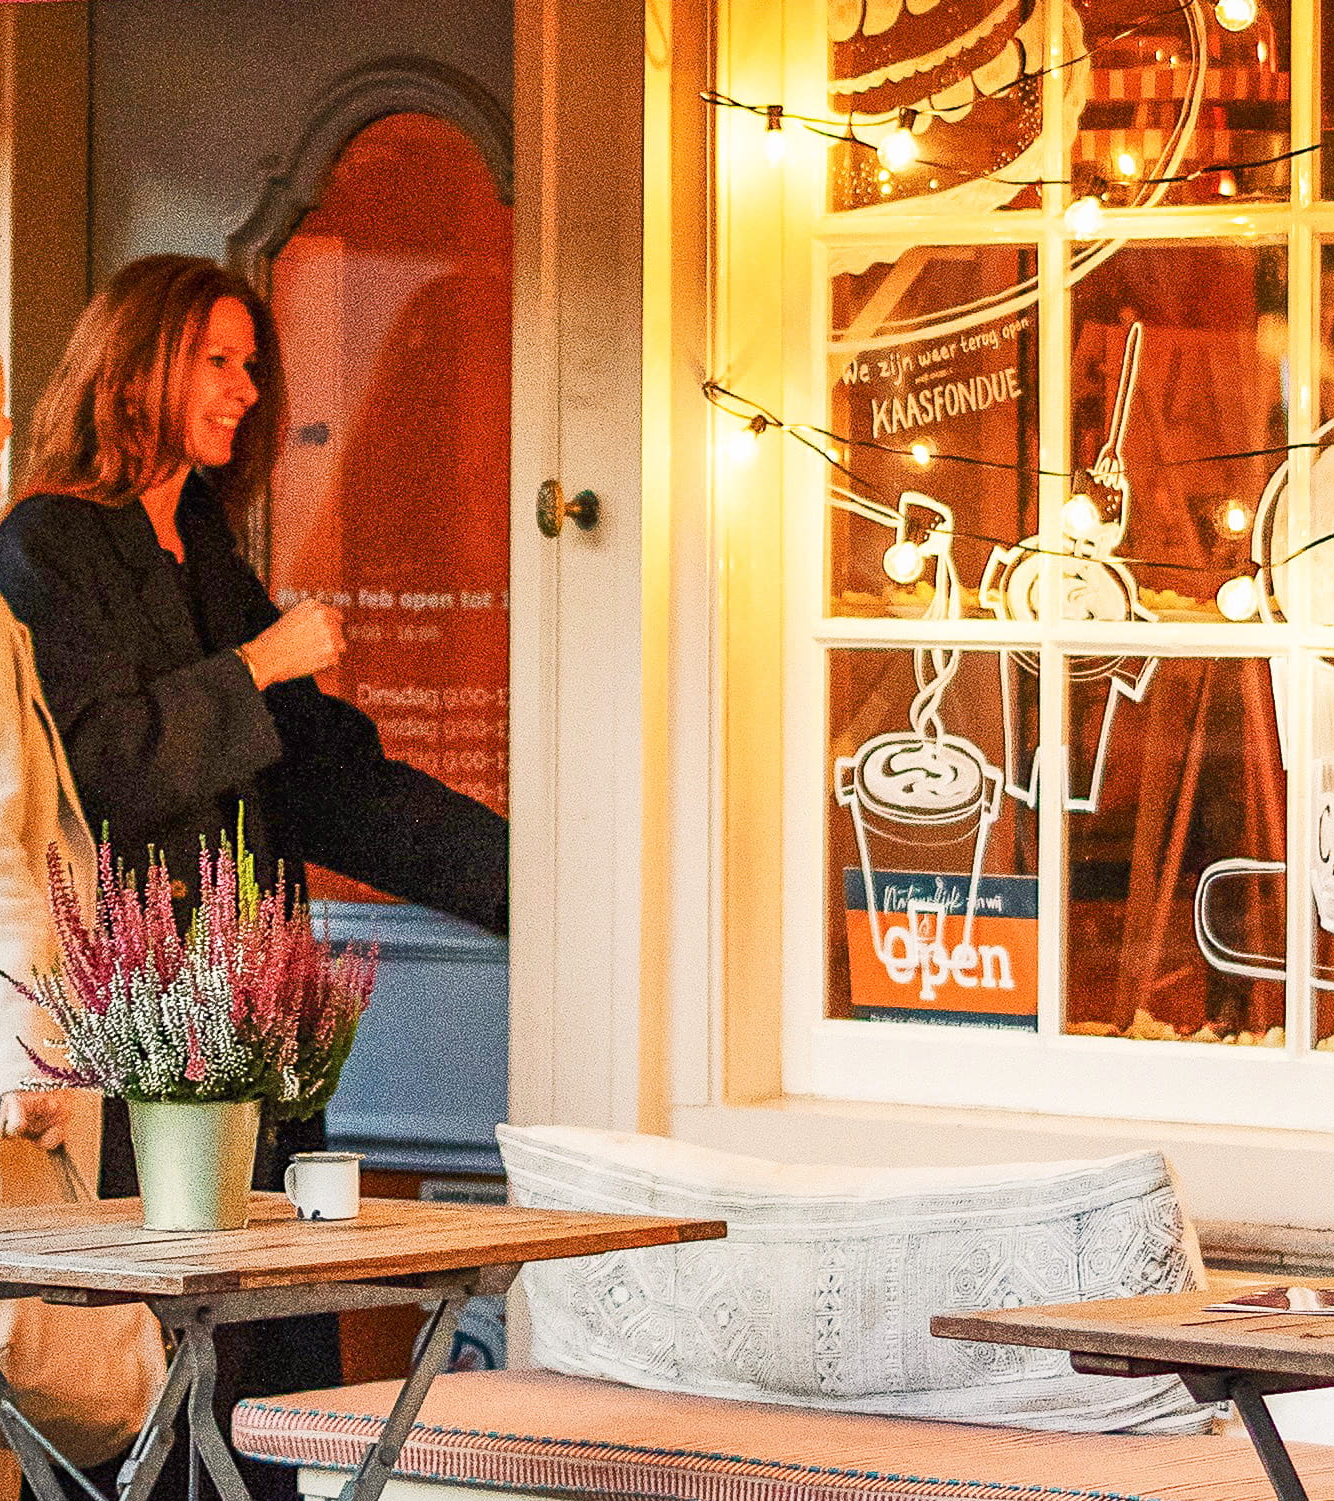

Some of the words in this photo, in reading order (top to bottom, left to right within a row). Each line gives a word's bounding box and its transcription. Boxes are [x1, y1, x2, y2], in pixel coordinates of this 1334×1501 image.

[842, 359, 870, 385] We
[877, 352, 914, 386] zijn
[917, 342, 958, 368] weer
[871, 366, 1023, 439] KAASFONDUE
